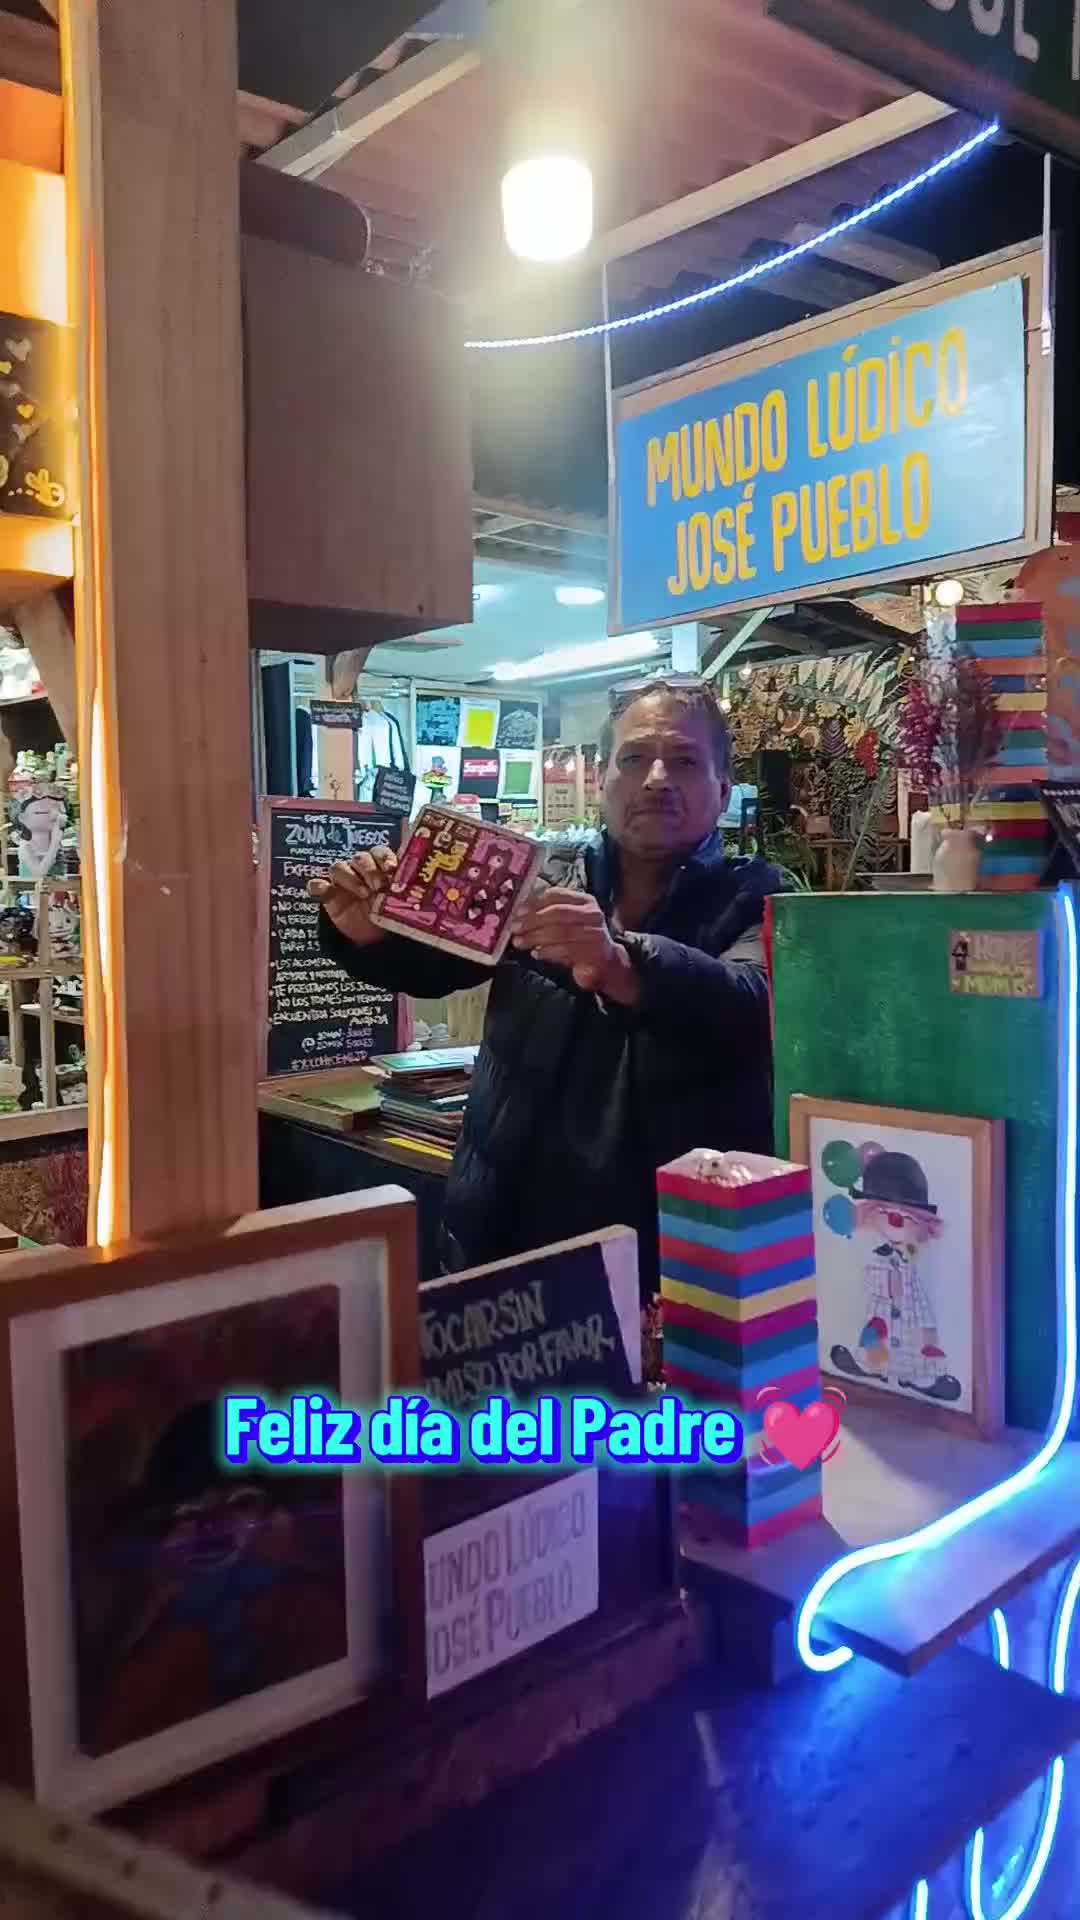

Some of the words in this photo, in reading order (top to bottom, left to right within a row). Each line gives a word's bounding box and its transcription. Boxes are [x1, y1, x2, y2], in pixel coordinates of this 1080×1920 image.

[647, 389, 787, 508] MUNDO
[667, 483, 756, 595] JOSÉ
[772, 451, 931, 572] PUEBLO
[285, 824, 326, 844] ZONA
[272, 984, 287, 997] TE
[288, 982, 338, 994] PRESTAMOS
[340, 982, 356, 992] LOS
[277, 998, 290, 1011] NO
[292, 997, 309, 1007] LOS
[310, 994, 342, 1004] TOMES
[539, 1314, 615, 1376] FAVOR
[430, 1529, 498, 1611] UNDO
[433, 1591, 480, 1676] OSÉ
[485, 1560, 573, 1653] PUEBLO
